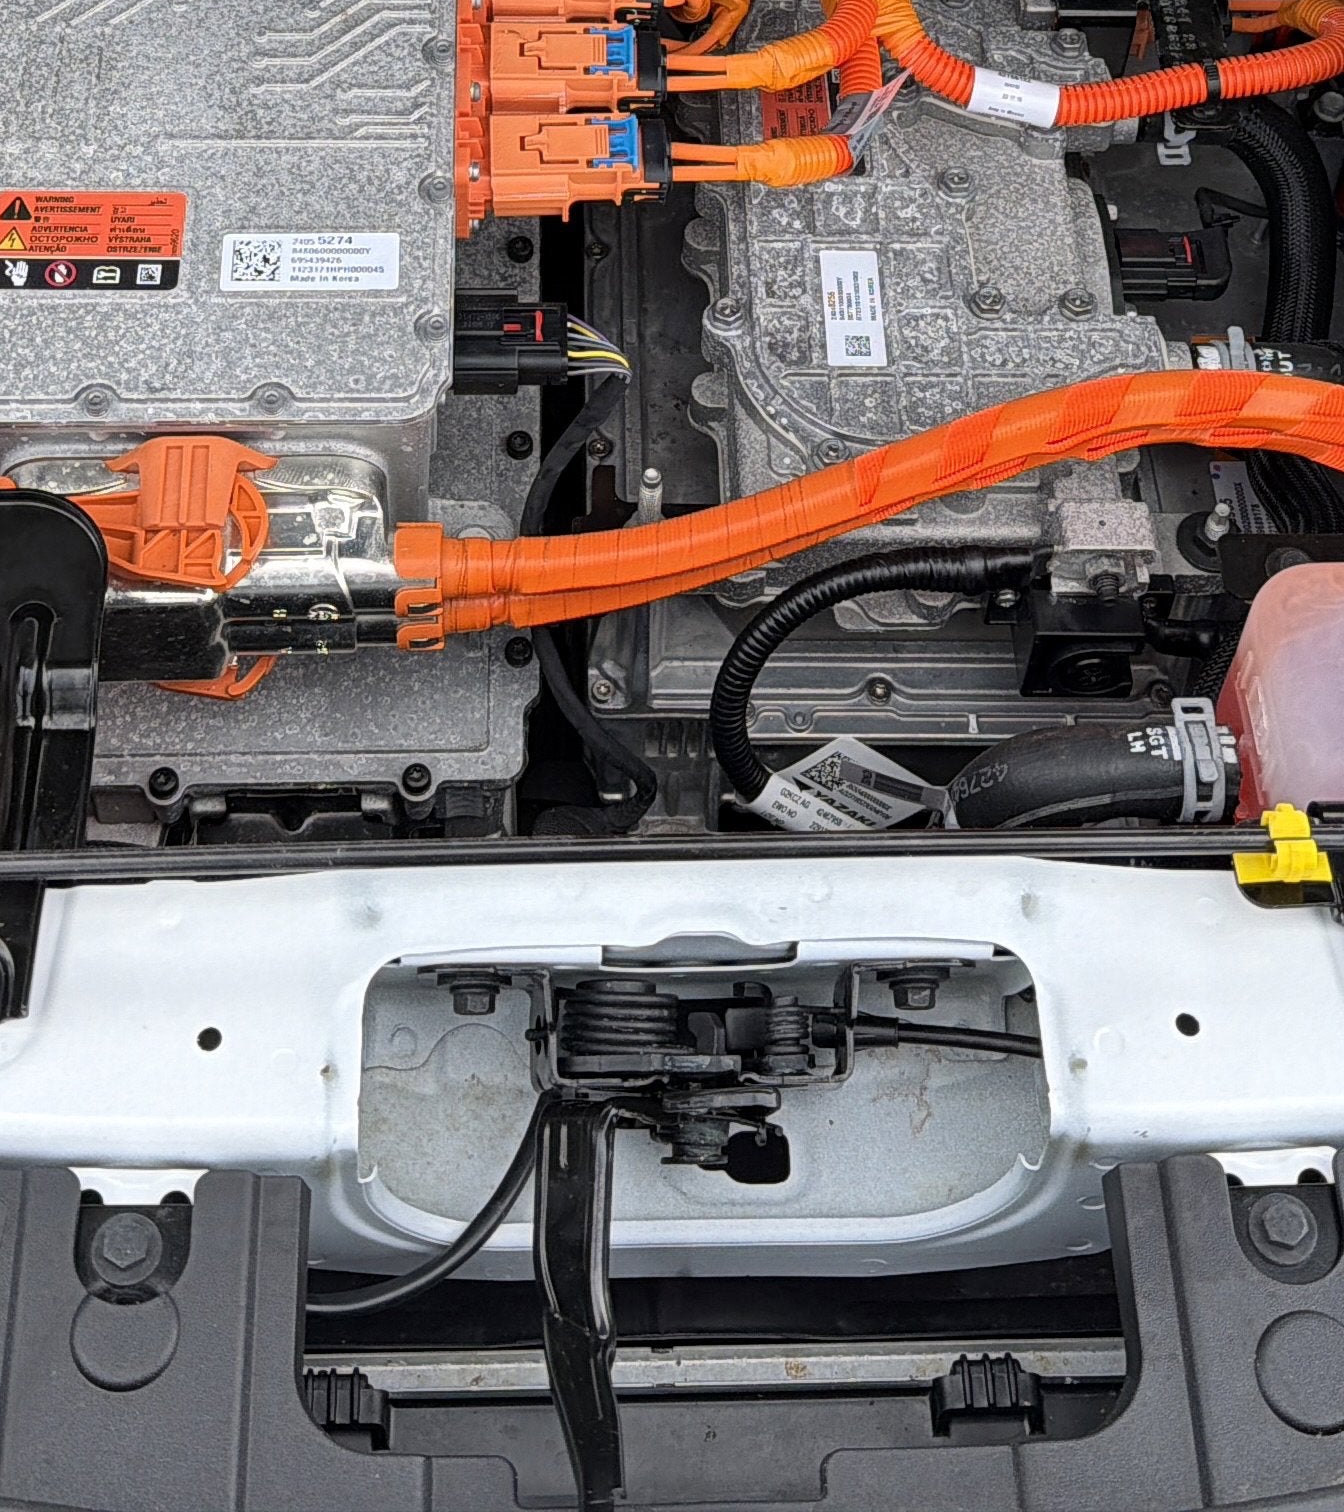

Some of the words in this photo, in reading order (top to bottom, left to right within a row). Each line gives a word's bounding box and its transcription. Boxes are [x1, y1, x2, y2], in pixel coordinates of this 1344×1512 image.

[317, 236, 352, 244] 5274
[1127, 731, 1146, 753] LH
[1146, 727, 1168, 759] SGT
[813, 790, 878, 827] YAZAKI
